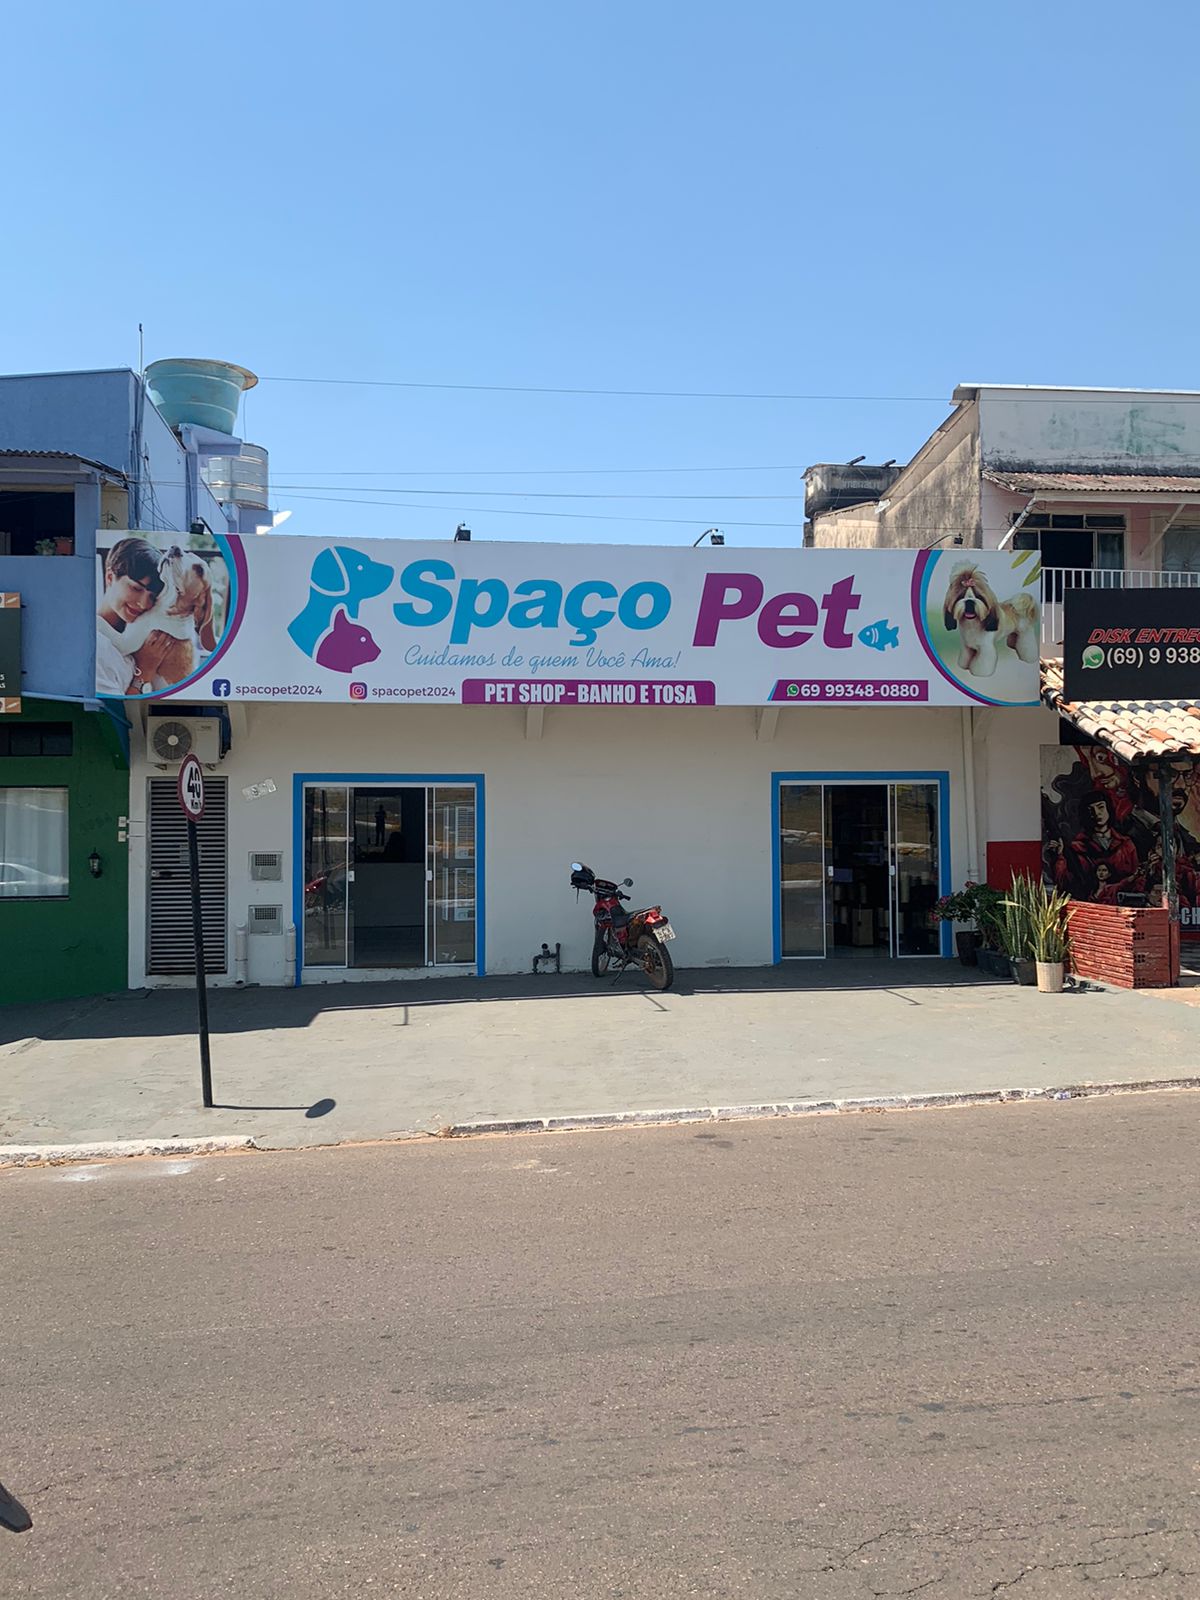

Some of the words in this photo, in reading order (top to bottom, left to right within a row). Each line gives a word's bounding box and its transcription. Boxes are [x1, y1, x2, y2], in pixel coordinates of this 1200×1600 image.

[393, 559, 671, 646] Spaço
[692, 572, 861, 648] Pet
[1088, 628, 1135, 643] DISK
[404, 644, 497, 666] Cuidamos
[501, 646, 525, 667] de
[528, 655, 579, 674] quem
[586, 647, 626, 667] Você
[630, 648, 681, 668] Ama!
[1107, 647, 1144, 668] (69)
[1149, 647, 1160, 664] 9
[235, 685, 322, 696] spacopet2024
[372, 687, 456, 698] spacopet2024
[484, 683, 515, 702] PET
[640, 684, 649, 703] E
[652, 684, 697, 704] TOSA
[800, 684, 820, 697] 69
[825, 684, 919, 697] 99348-0880
[187, 766, 201, 799] 40
